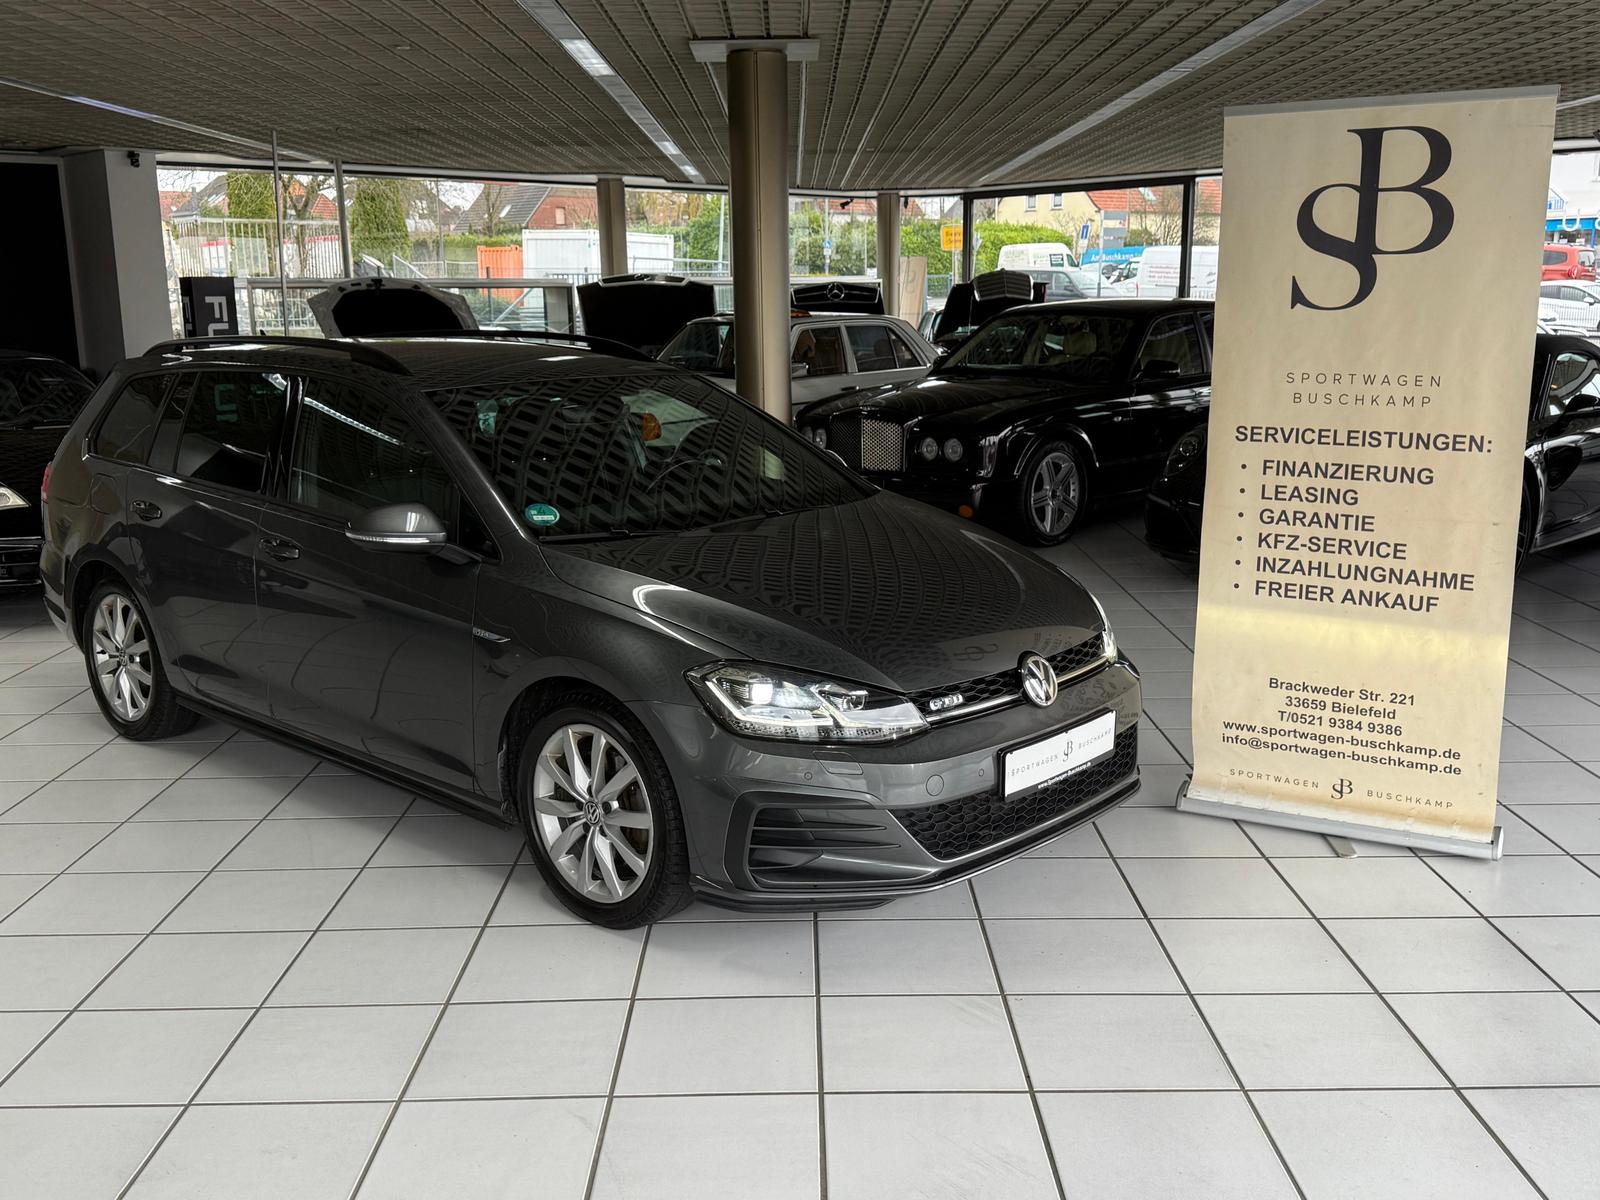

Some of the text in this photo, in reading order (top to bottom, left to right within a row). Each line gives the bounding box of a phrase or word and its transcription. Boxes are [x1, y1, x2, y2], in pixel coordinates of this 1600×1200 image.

[1286, 372, 1443, 388] SPORTWAGEN
[1292, 393, 1432, 408] BUSCHKAMP
[1235, 425, 1493, 454] SERVICELEISTUNGEN:
[1262, 459, 1435, 486] FINANZIERUNG
[1260, 484, 1360, 506] LEASING
[1259, 508, 1376, 533] GARANTIE
[1257, 532, 1408, 560] KFZ-SERVICE
[1255, 556, 1475, 592] INZAHLUNGNAHME
[1254, 580, 1440, 613] FREIER ANKAUF
[1269, 678, 1416, 707] Brackweder Str. 221
[1285, 695, 1397, 721] 33659 Bielefeld
[1277, 709, 1404, 737] T/0521 9384 9386
[1221, 732, 1463, 776] info@sportwagen-buschkamp.de
[1222, 720, 1462, 761] www.sportwagen-buschkamp.de
[1229, 767, 1321, 789] SPORTWAGEN
[1366, 789, 1455, 809] BUSCHKAMP
